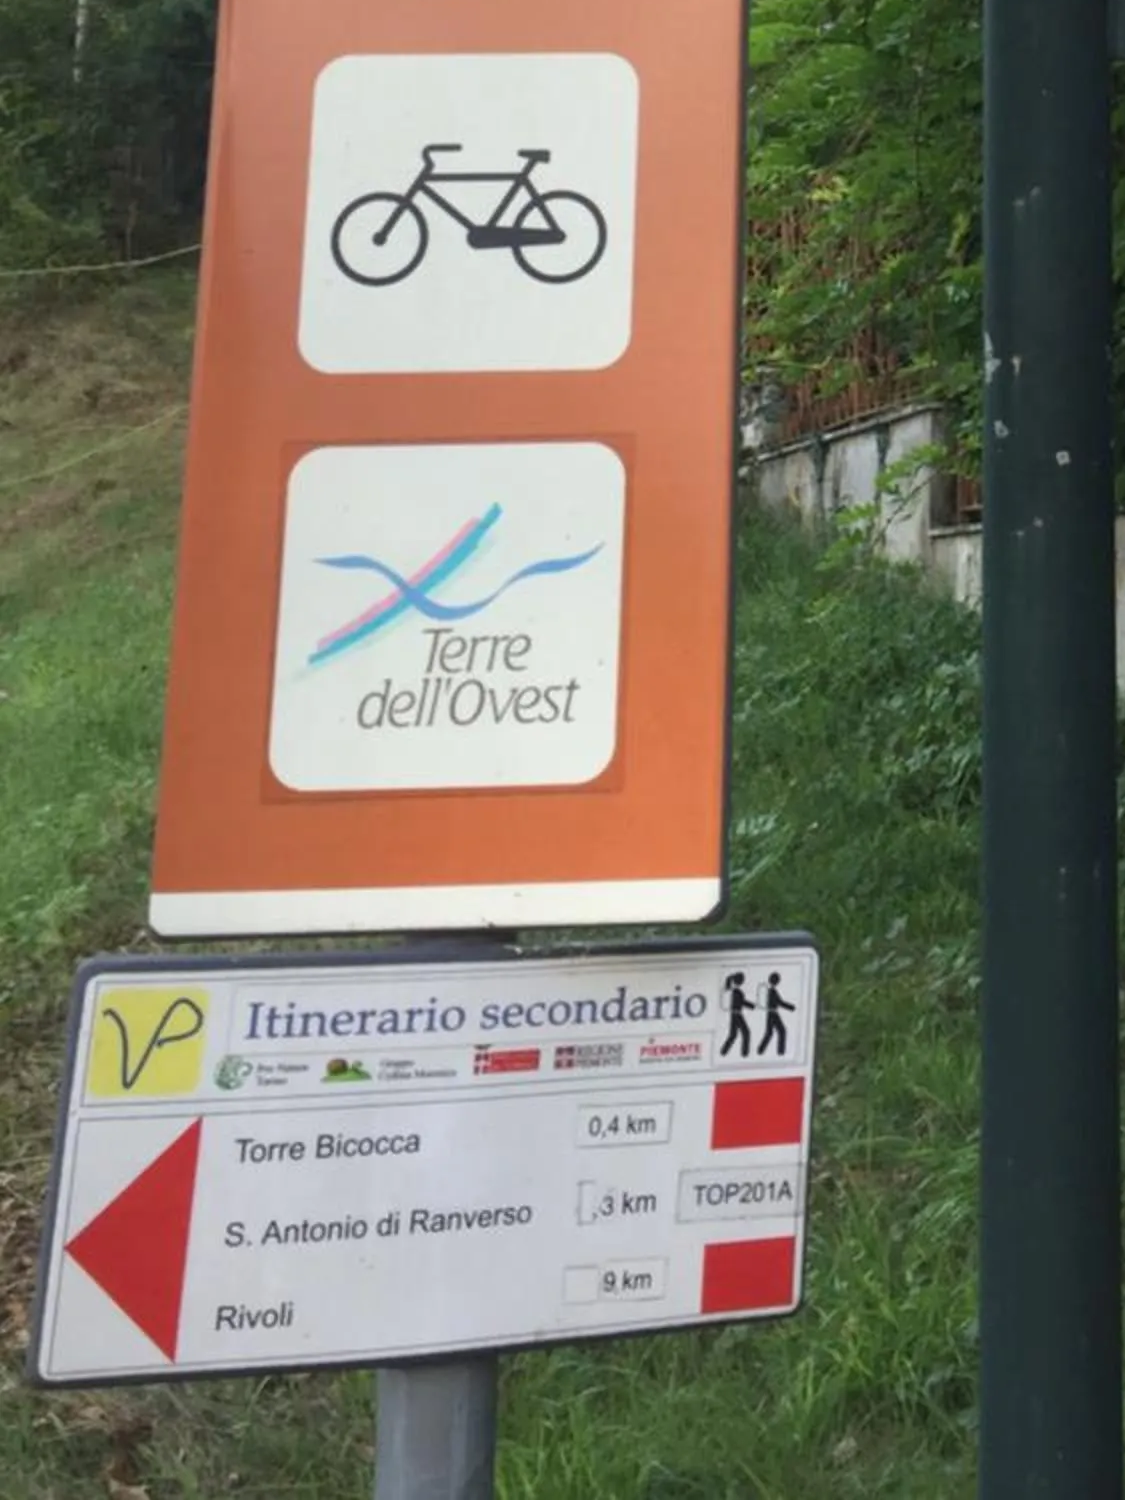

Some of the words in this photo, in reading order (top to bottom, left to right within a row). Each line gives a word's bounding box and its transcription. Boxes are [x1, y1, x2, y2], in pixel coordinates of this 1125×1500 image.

[422, 627, 532, 674] Terre
[356, 677, 581, 729] dell'Ovest
[242, 996, 466, 1044] Itinerario
[479, 985, 709, 1032] secondario
[235, 1136, 305, 1164] Torre
[316, 1130, 421, 1160] Bicocca
[588, 1116, 619, 1138] 0,4
[626, 1115, 656, 1134] km
[693, 1180, 793, 1206] TOP201A
[224, 1221, 254, 1249] S.
[261, 1215, 368, 1246] Antonio
[376, 1210, 400, 1238] di
[408, 1201, 532, 1236] Ranverso
[622, 1192, 657, 1215] km
[214, 1301, 294, 1332] Rivoli
[621, 1270, 652, 1291] km
